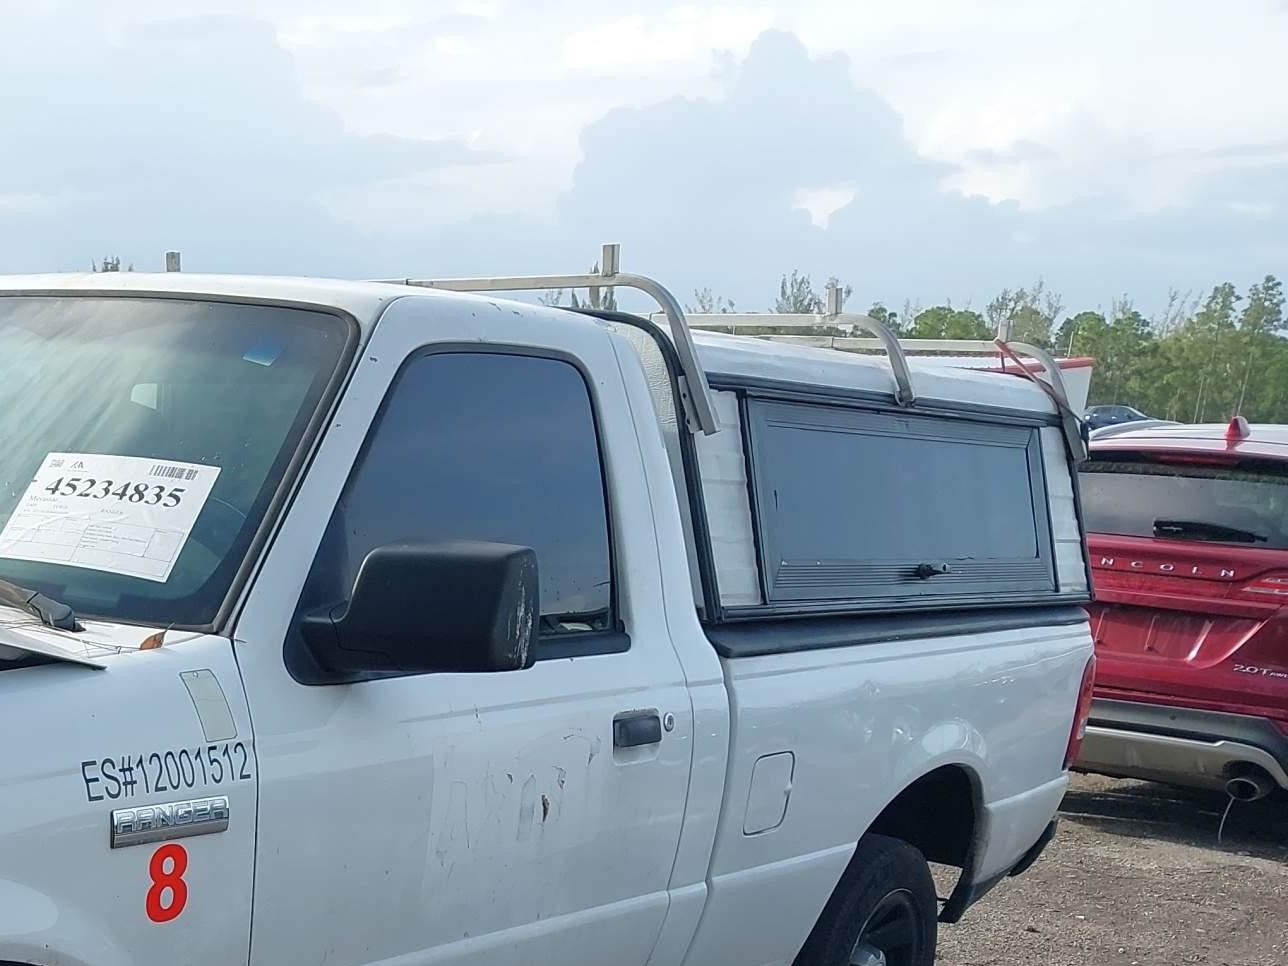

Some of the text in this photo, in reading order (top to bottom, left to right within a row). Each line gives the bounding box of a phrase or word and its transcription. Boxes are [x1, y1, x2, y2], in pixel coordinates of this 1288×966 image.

[45, 476, 186, 508] 45234835
[1100, 557, 1235, 577] NCOLN
[81, 742, 251, 801] ES#12001512
[116, 799, 228, 833] RANGER
[146, 843, 188, 923] 8
